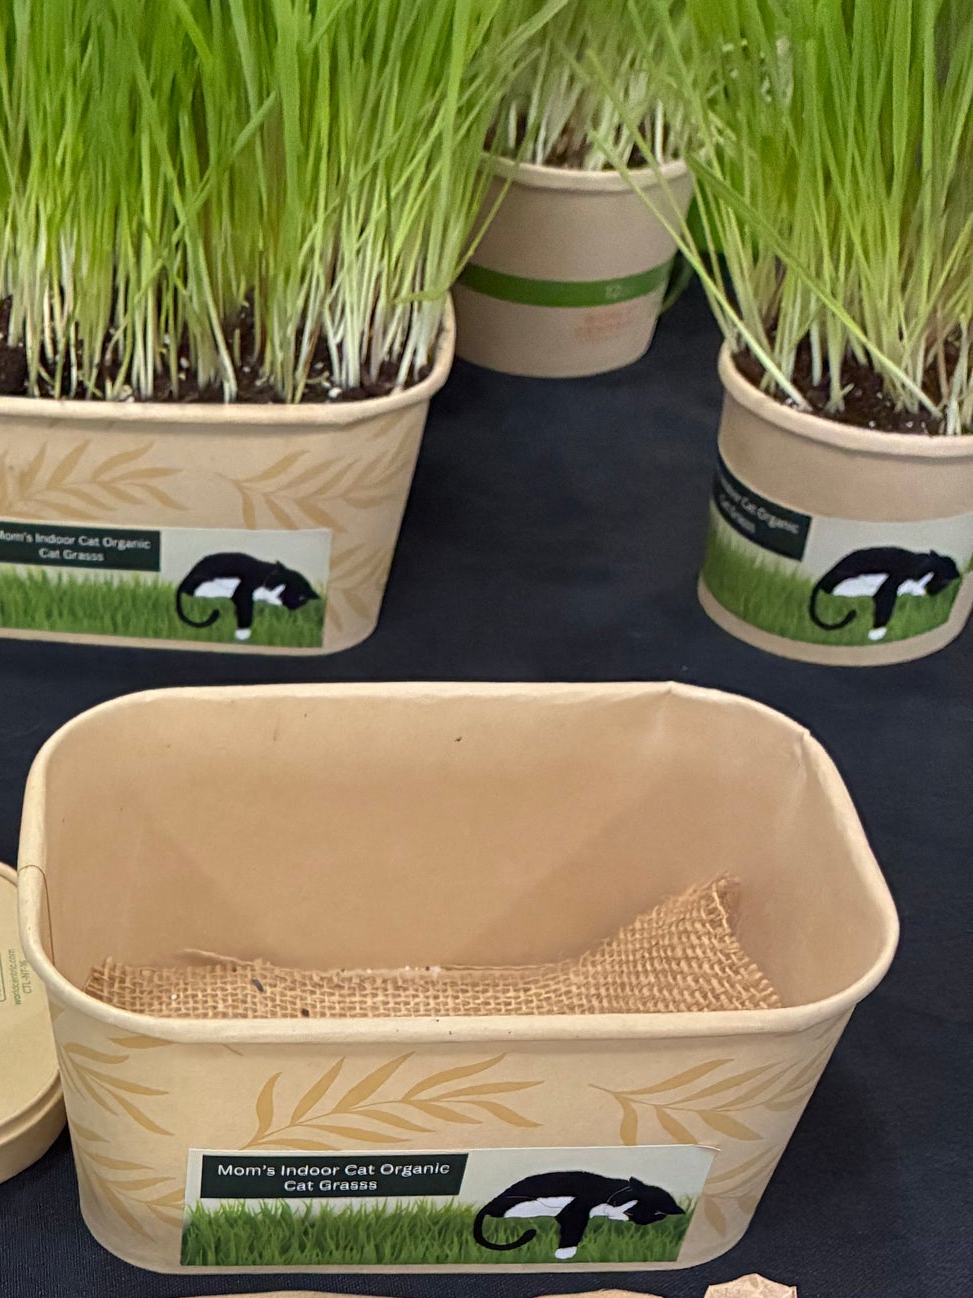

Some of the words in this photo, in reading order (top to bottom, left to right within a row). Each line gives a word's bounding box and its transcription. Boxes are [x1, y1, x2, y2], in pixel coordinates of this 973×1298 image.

[35, 532, 76, 547] Indoor
[78, 535, 101, 548] Cat
[102, 536, 152, 552] Organic
[38, 548, 61, 559] Cat
[217, 1163, 276, 1177] Mom's
[280, 1164, 340, 1177] Indoor
[344, 1163, 376, 1176] Cat
[379, 1162, 450, 1178] Organic
[284, 1180, 315, 1192] Cat
[319, 1179, 378, 1192] Grasss
